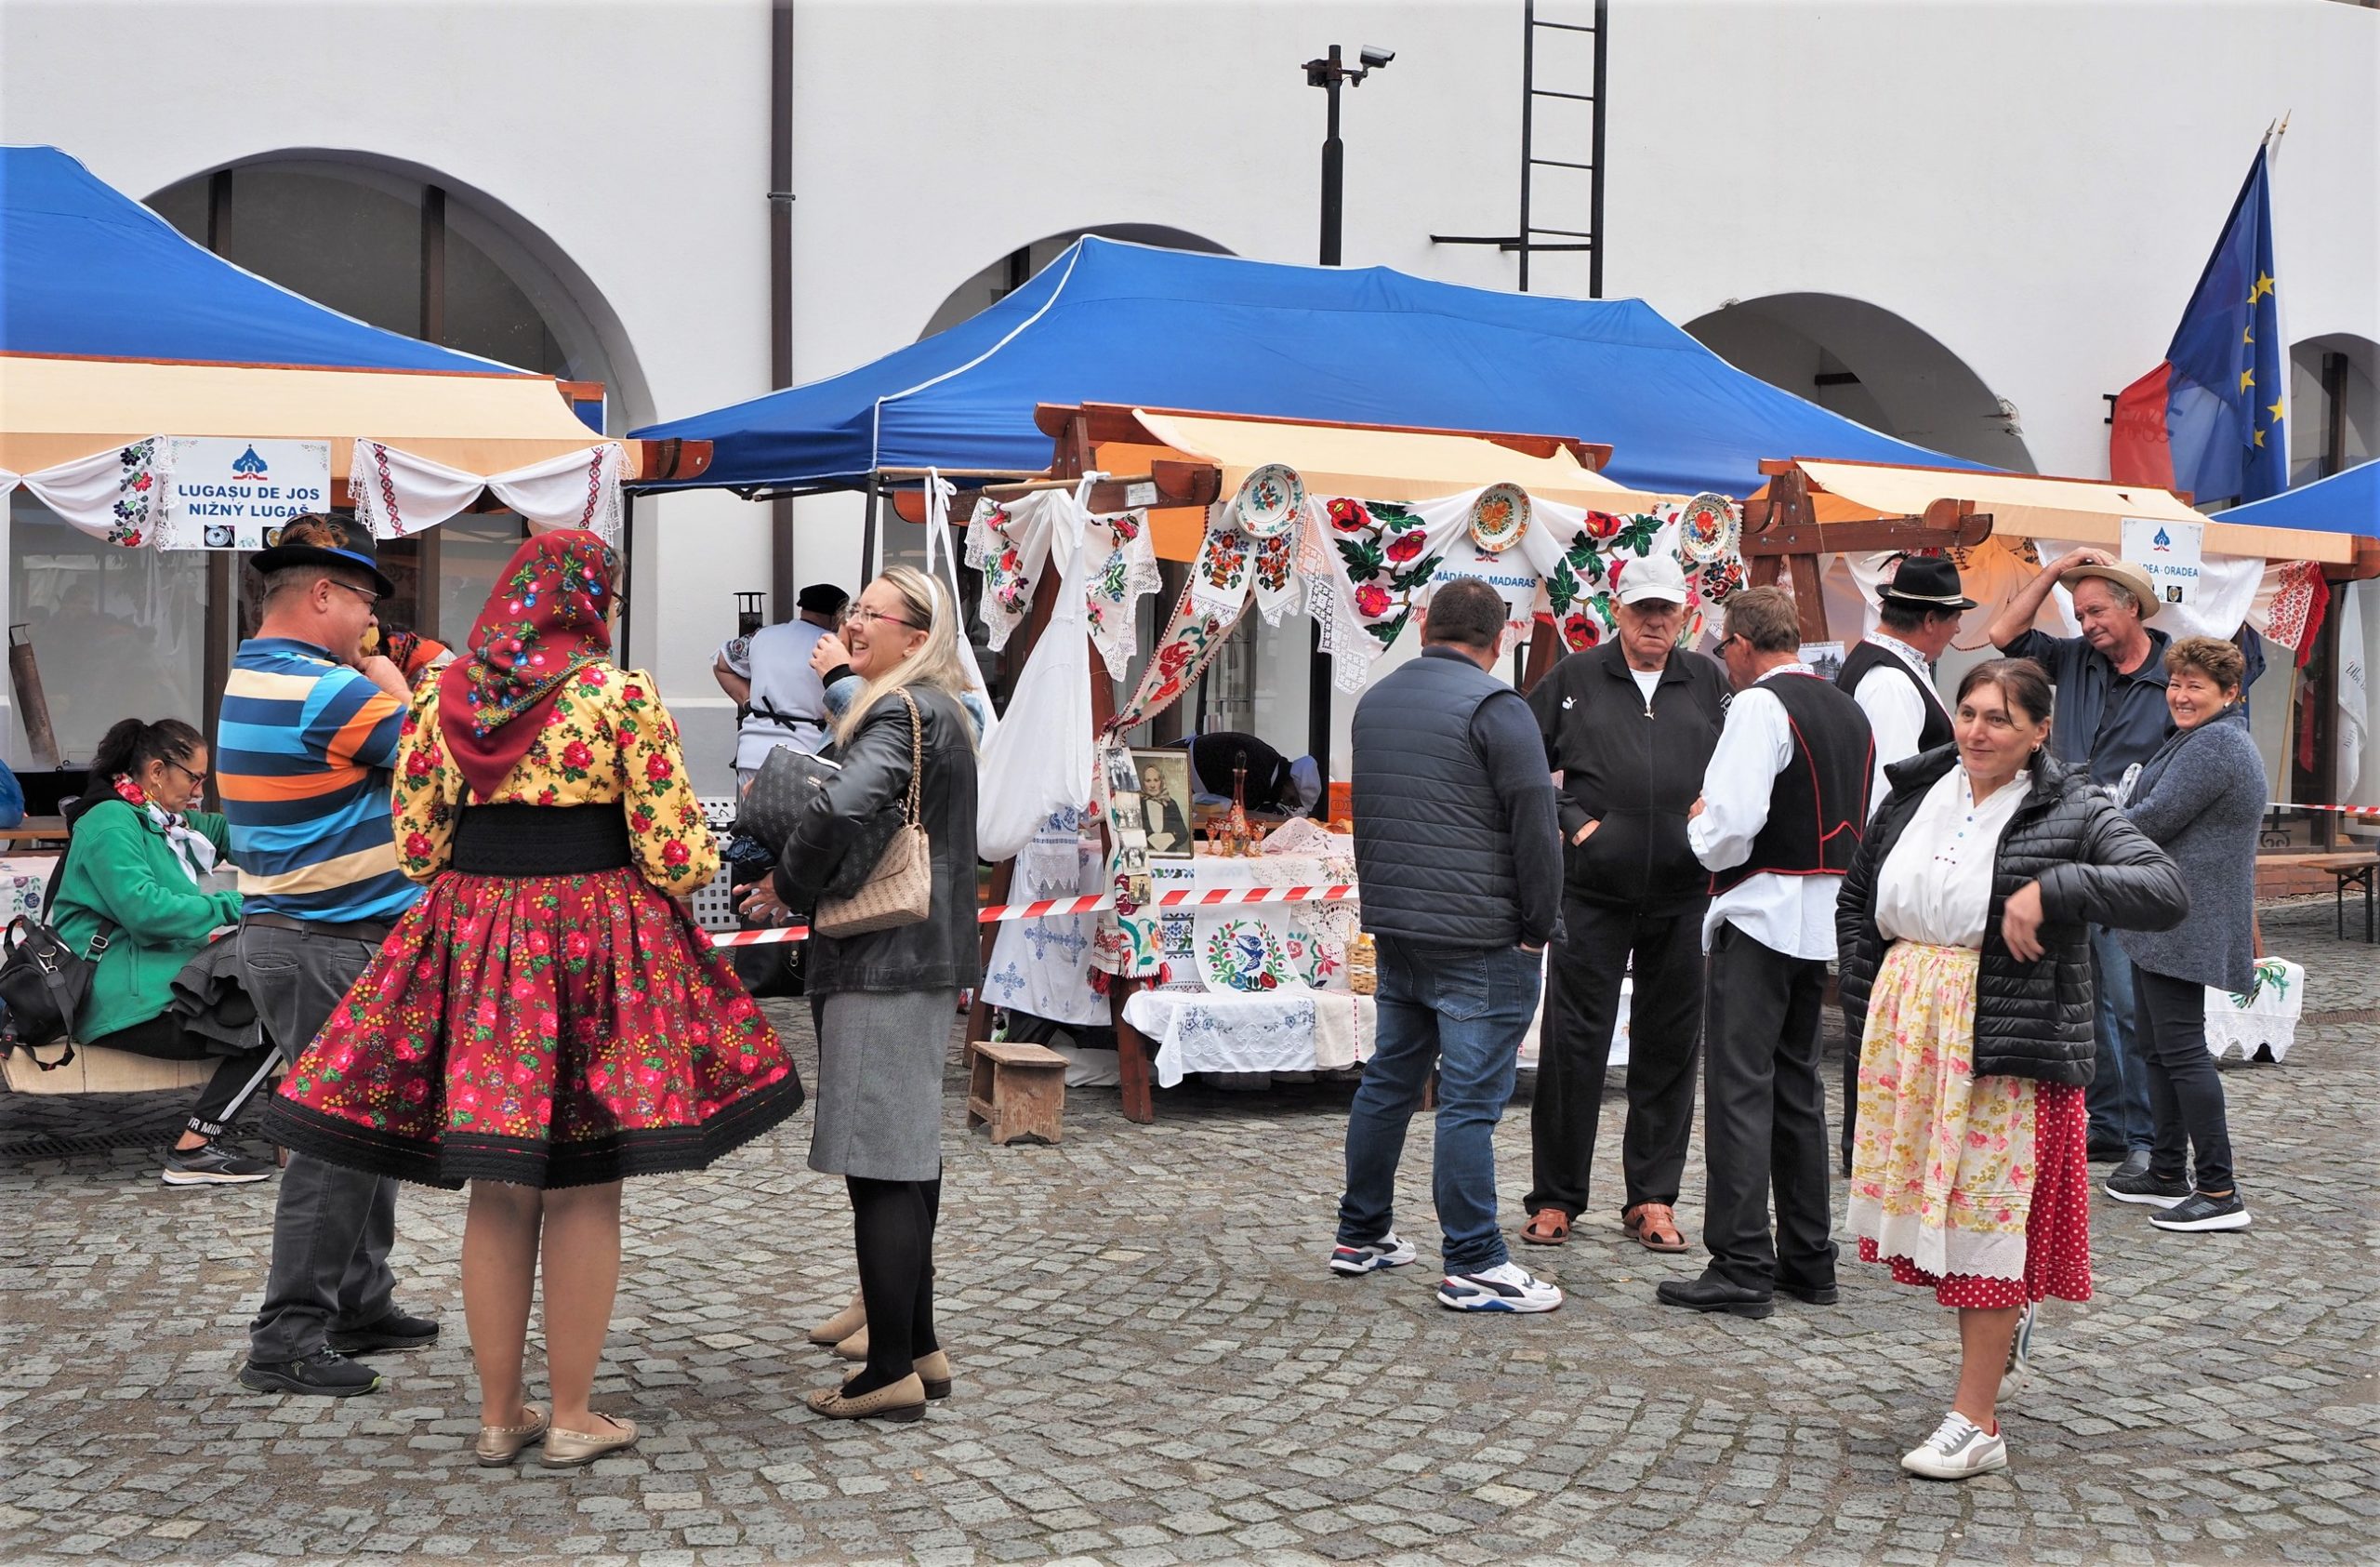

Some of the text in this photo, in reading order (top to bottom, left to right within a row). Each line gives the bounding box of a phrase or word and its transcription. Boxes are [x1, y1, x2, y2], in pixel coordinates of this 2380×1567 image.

[258, 486, 280, 499] DE
[285, 487, 320, 500] JOS
[189, 500, 244, 516] NIŽNÝ
[2164, 565, 2199, 577] ORADEA
[1488, 576, 1537, 588] MADARAS
